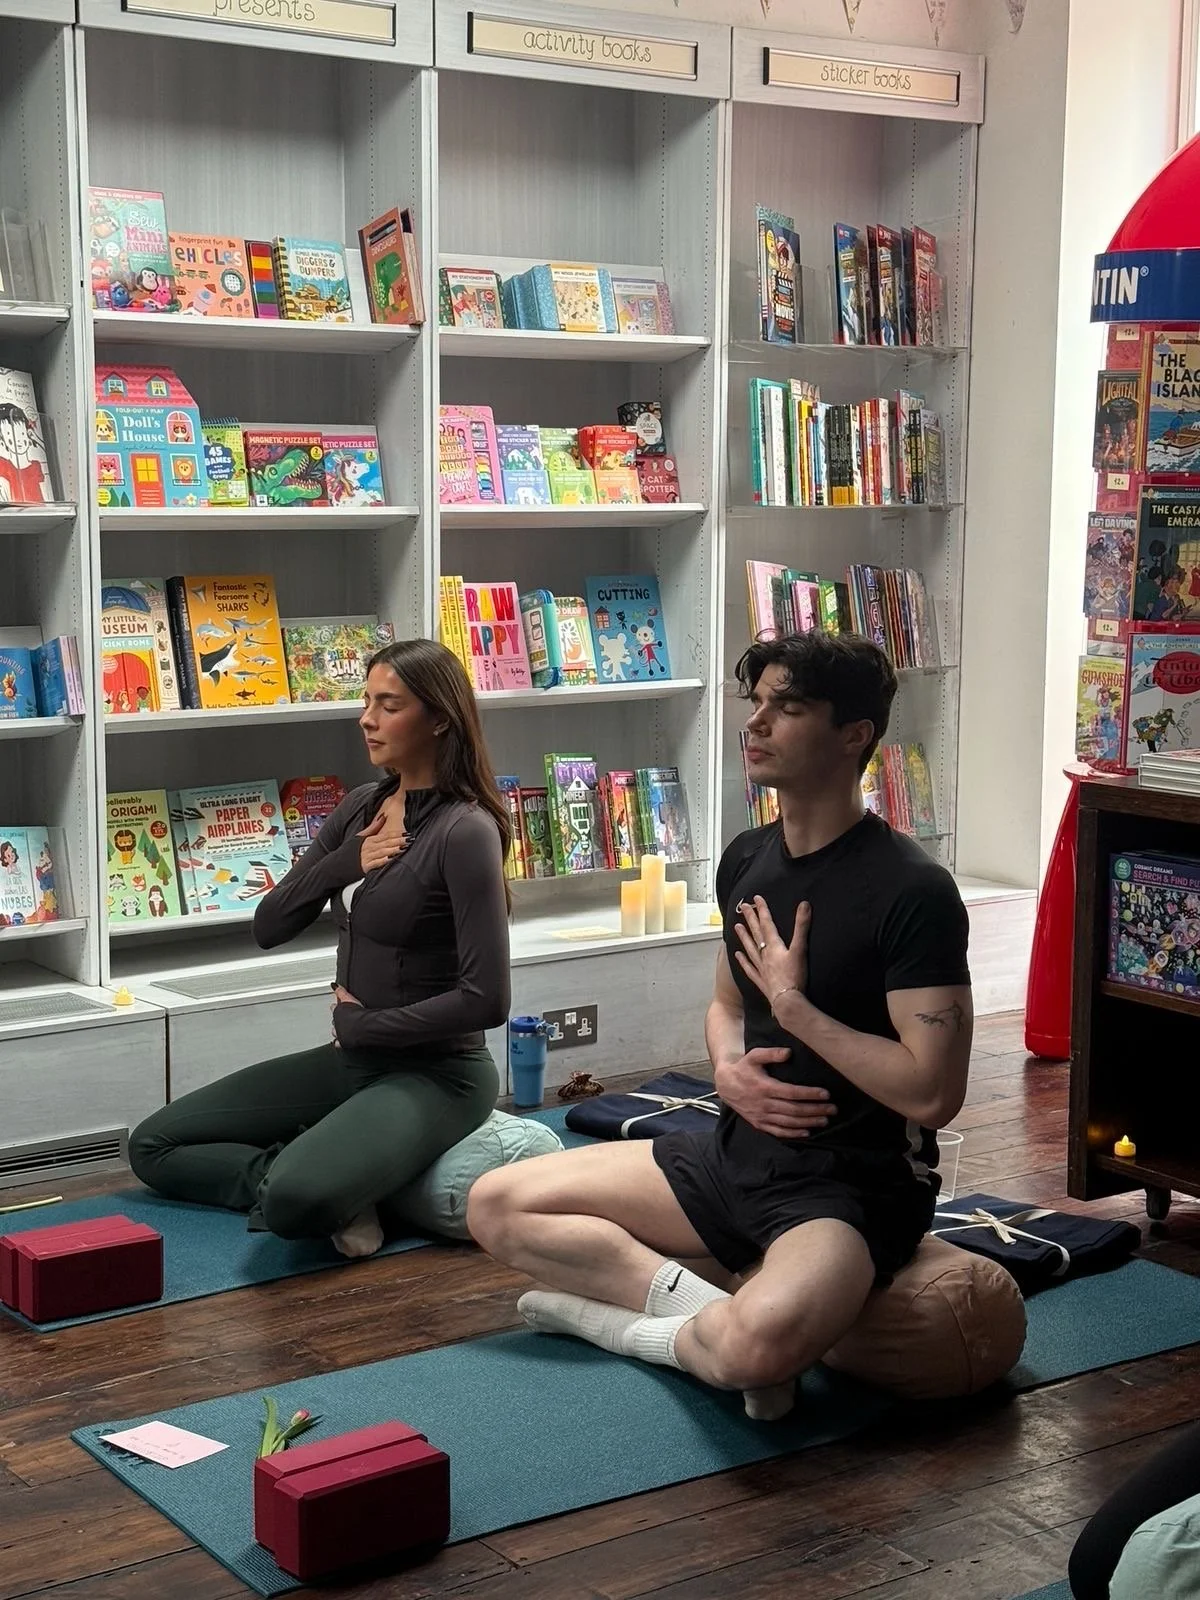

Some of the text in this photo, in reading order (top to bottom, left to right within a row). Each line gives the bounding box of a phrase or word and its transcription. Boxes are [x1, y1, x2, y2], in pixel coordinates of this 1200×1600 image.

[523, 30, 652, 62] activity books
[820, 62, 911, 90] sticker books
[125, 225, 164, 243] Mini
[212, 238, 223, 246] fun
[296, 255, 336, 268] DIGGERS &
[299, 265, 336, 278] DUMPERS
[1158, 353, 1187, 368] THE
[122, 415, 161, 428] Doll's
[121, 430, 165, 443] House
[248, 436, 284, 445] MAGNETIC
[284, 436, 309, 444] PUZZLE
[208, 446, 224, 457] 45
[647, 475, 664, 484] CAT
[1151, 504, 1170, 515] THE
[213, 581, 248, 591] Fantastic
[213, 591, 250, 601] Fearsome
[597, 588, 651, 601] CUTTING
[216, 602, 250, 612] SHARKS
[464, 587, 516, 622] RAW
[112, 615, 137, 623] LITTLE
[470, 623, 520, 657] APPY
[328, 660, 361, 677] SLAM
[200, 795, 261, 809] ULTRA LONG FLIGHT
[110, 804, 157, 818] ORIGAMI
[216, 806, 250, 822] PAPER
[207, 819, 265, 839] AIRPLANES
[1153, 865, 1174, 875] DREAMS
[1133, 870, 1162, 881] SEARCH
[1163, 875, 1170, 883] &
[1170, 876, 1188, 886] FIND
[1, 895, 33, 910] NUBES
